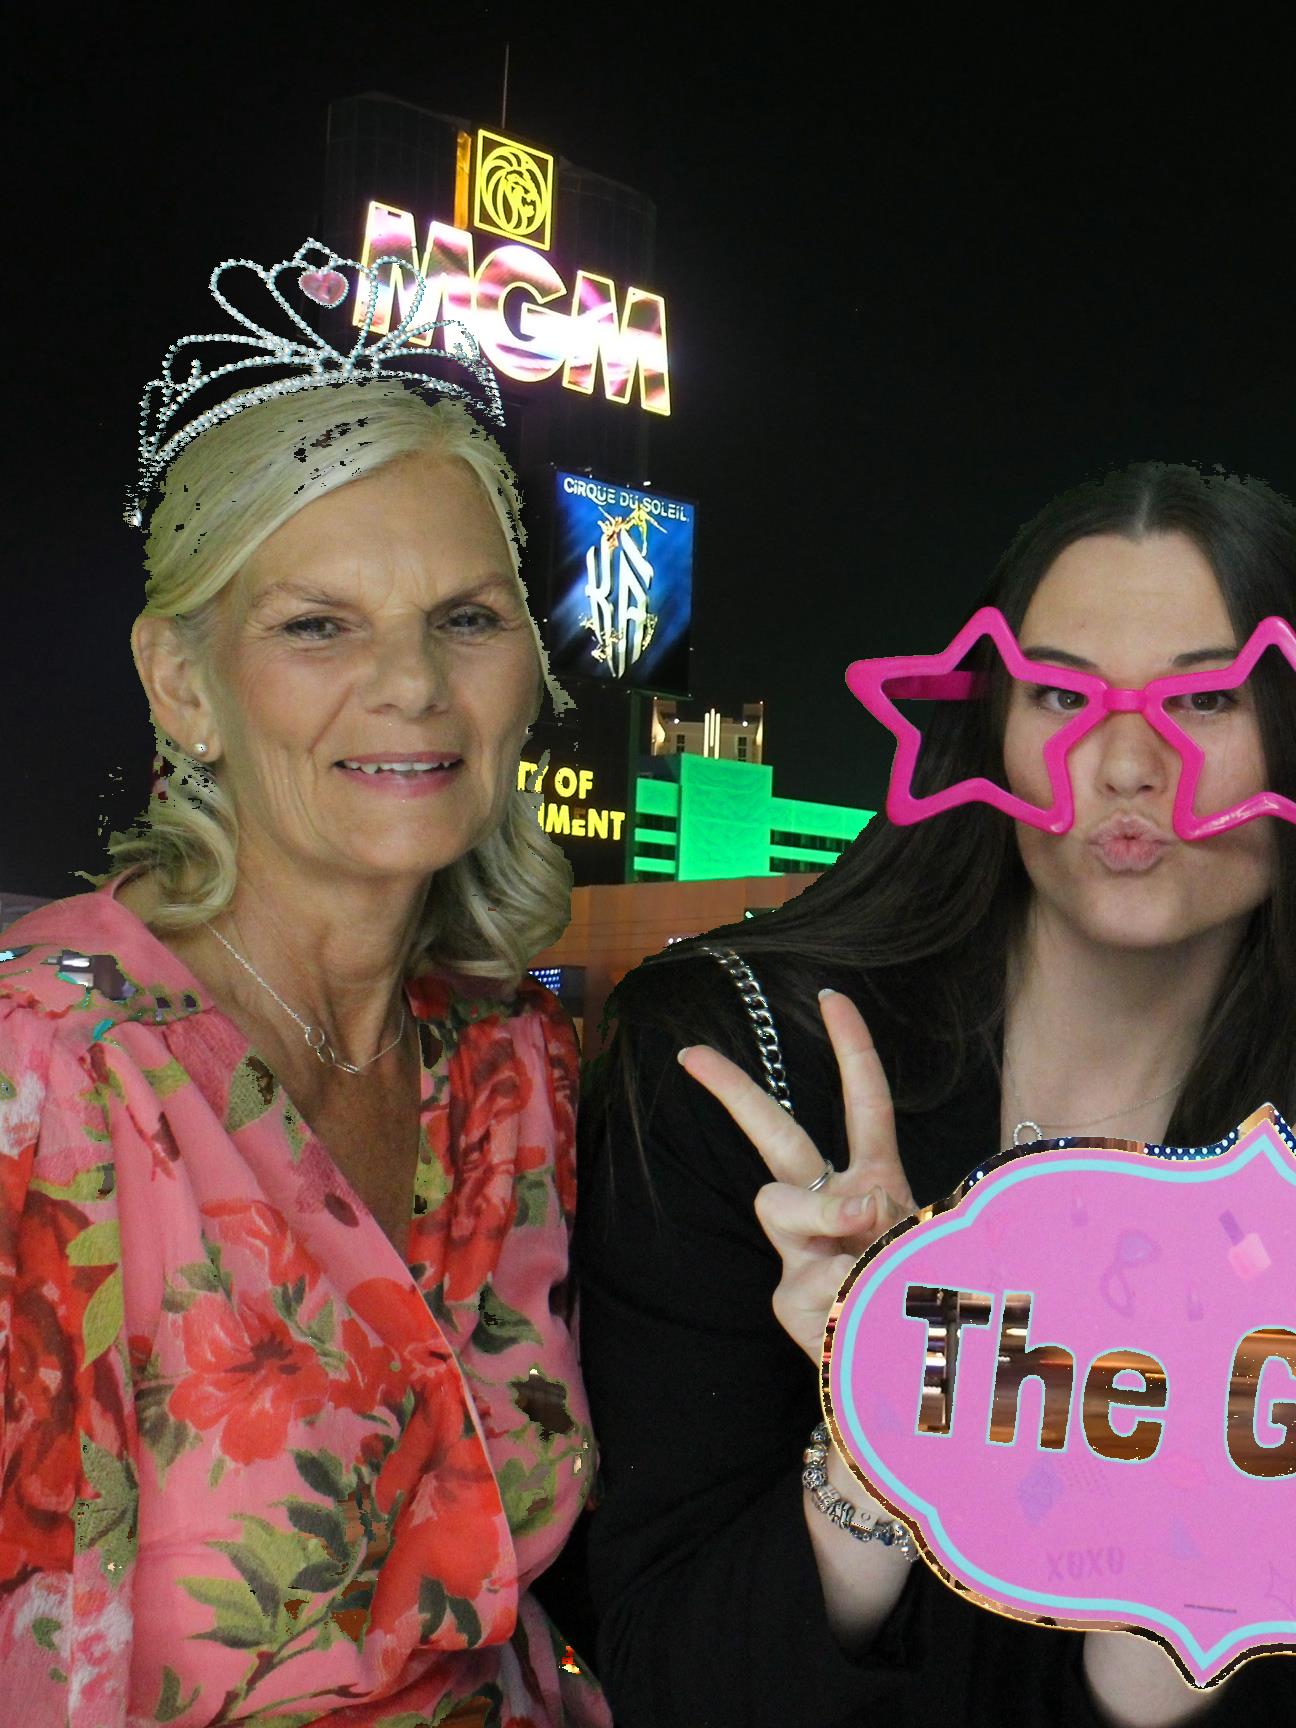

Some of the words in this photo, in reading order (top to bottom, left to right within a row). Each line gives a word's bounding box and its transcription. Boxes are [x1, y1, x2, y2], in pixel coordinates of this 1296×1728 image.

[352, 201, 671, 416] MGM
[563, 477, 616, 505] CIRQUE
[620, 492, 638, 509] DU
[643, 498, 687, 521] SOLEIL
[555, 767, 593, 799] OF
[902, 1284, 1168, 1463] The
[1045, 1546, 1126, 1580] XOXO
